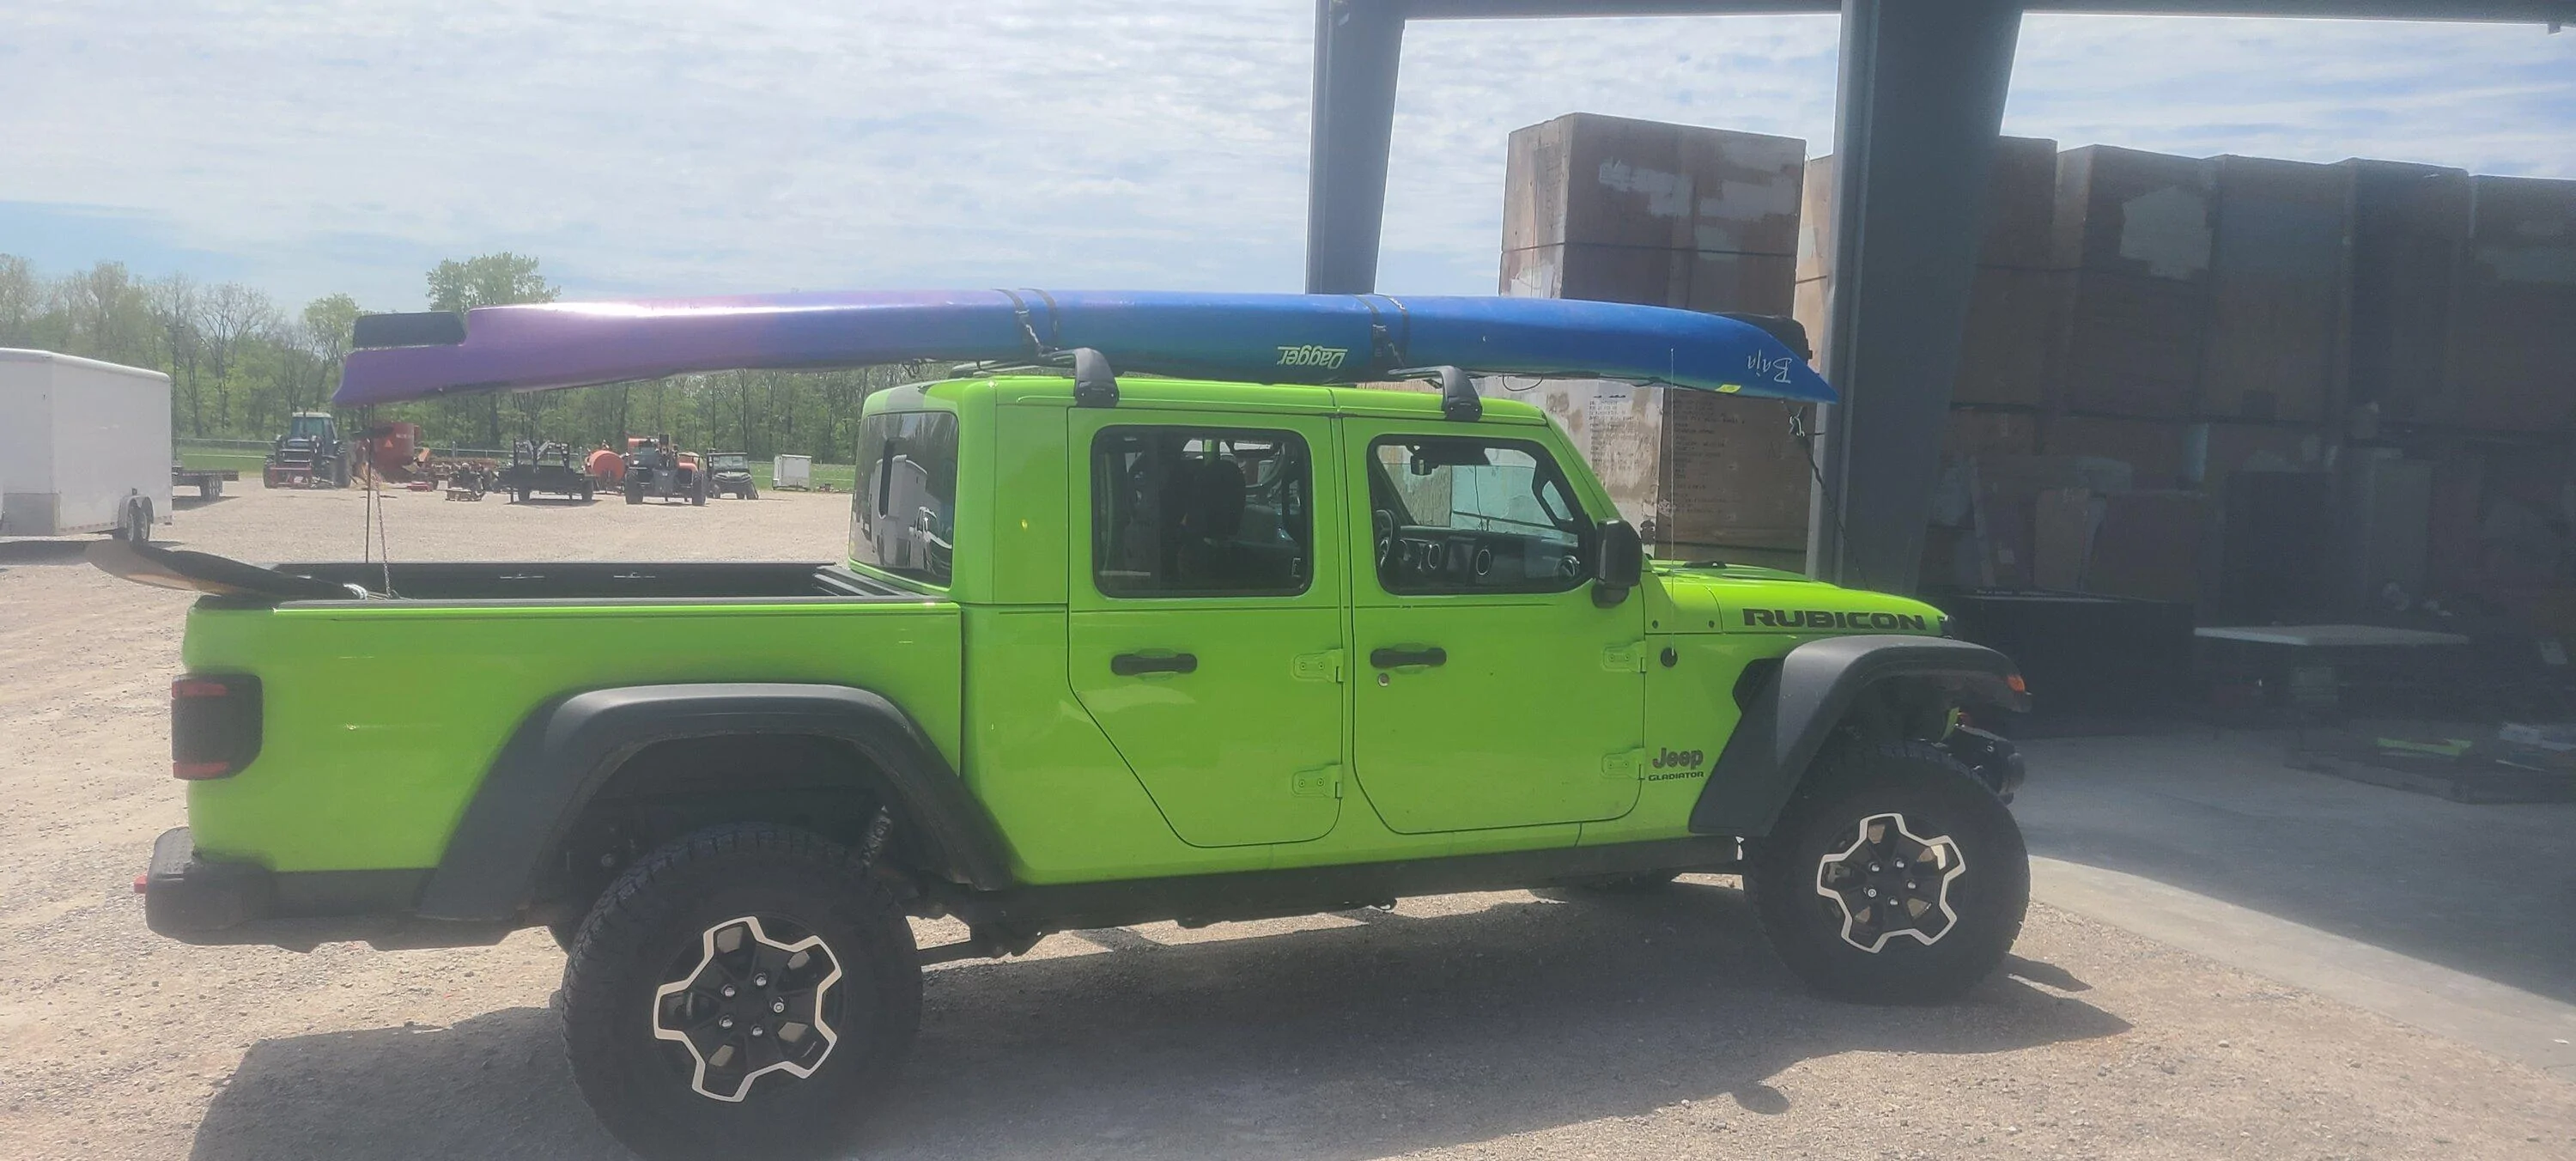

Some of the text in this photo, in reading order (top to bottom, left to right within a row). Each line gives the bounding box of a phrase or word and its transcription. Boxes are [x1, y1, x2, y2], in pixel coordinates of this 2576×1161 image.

[1277, 345, 1347, 369] Dagger
[1747, 349, 1792, 384] Baja
[1742, 608, 1926, 631] RUBICON
[1652, 747, 1704, 769] Jeep
[1648, 771, 1704, 781] GLADIATOR
